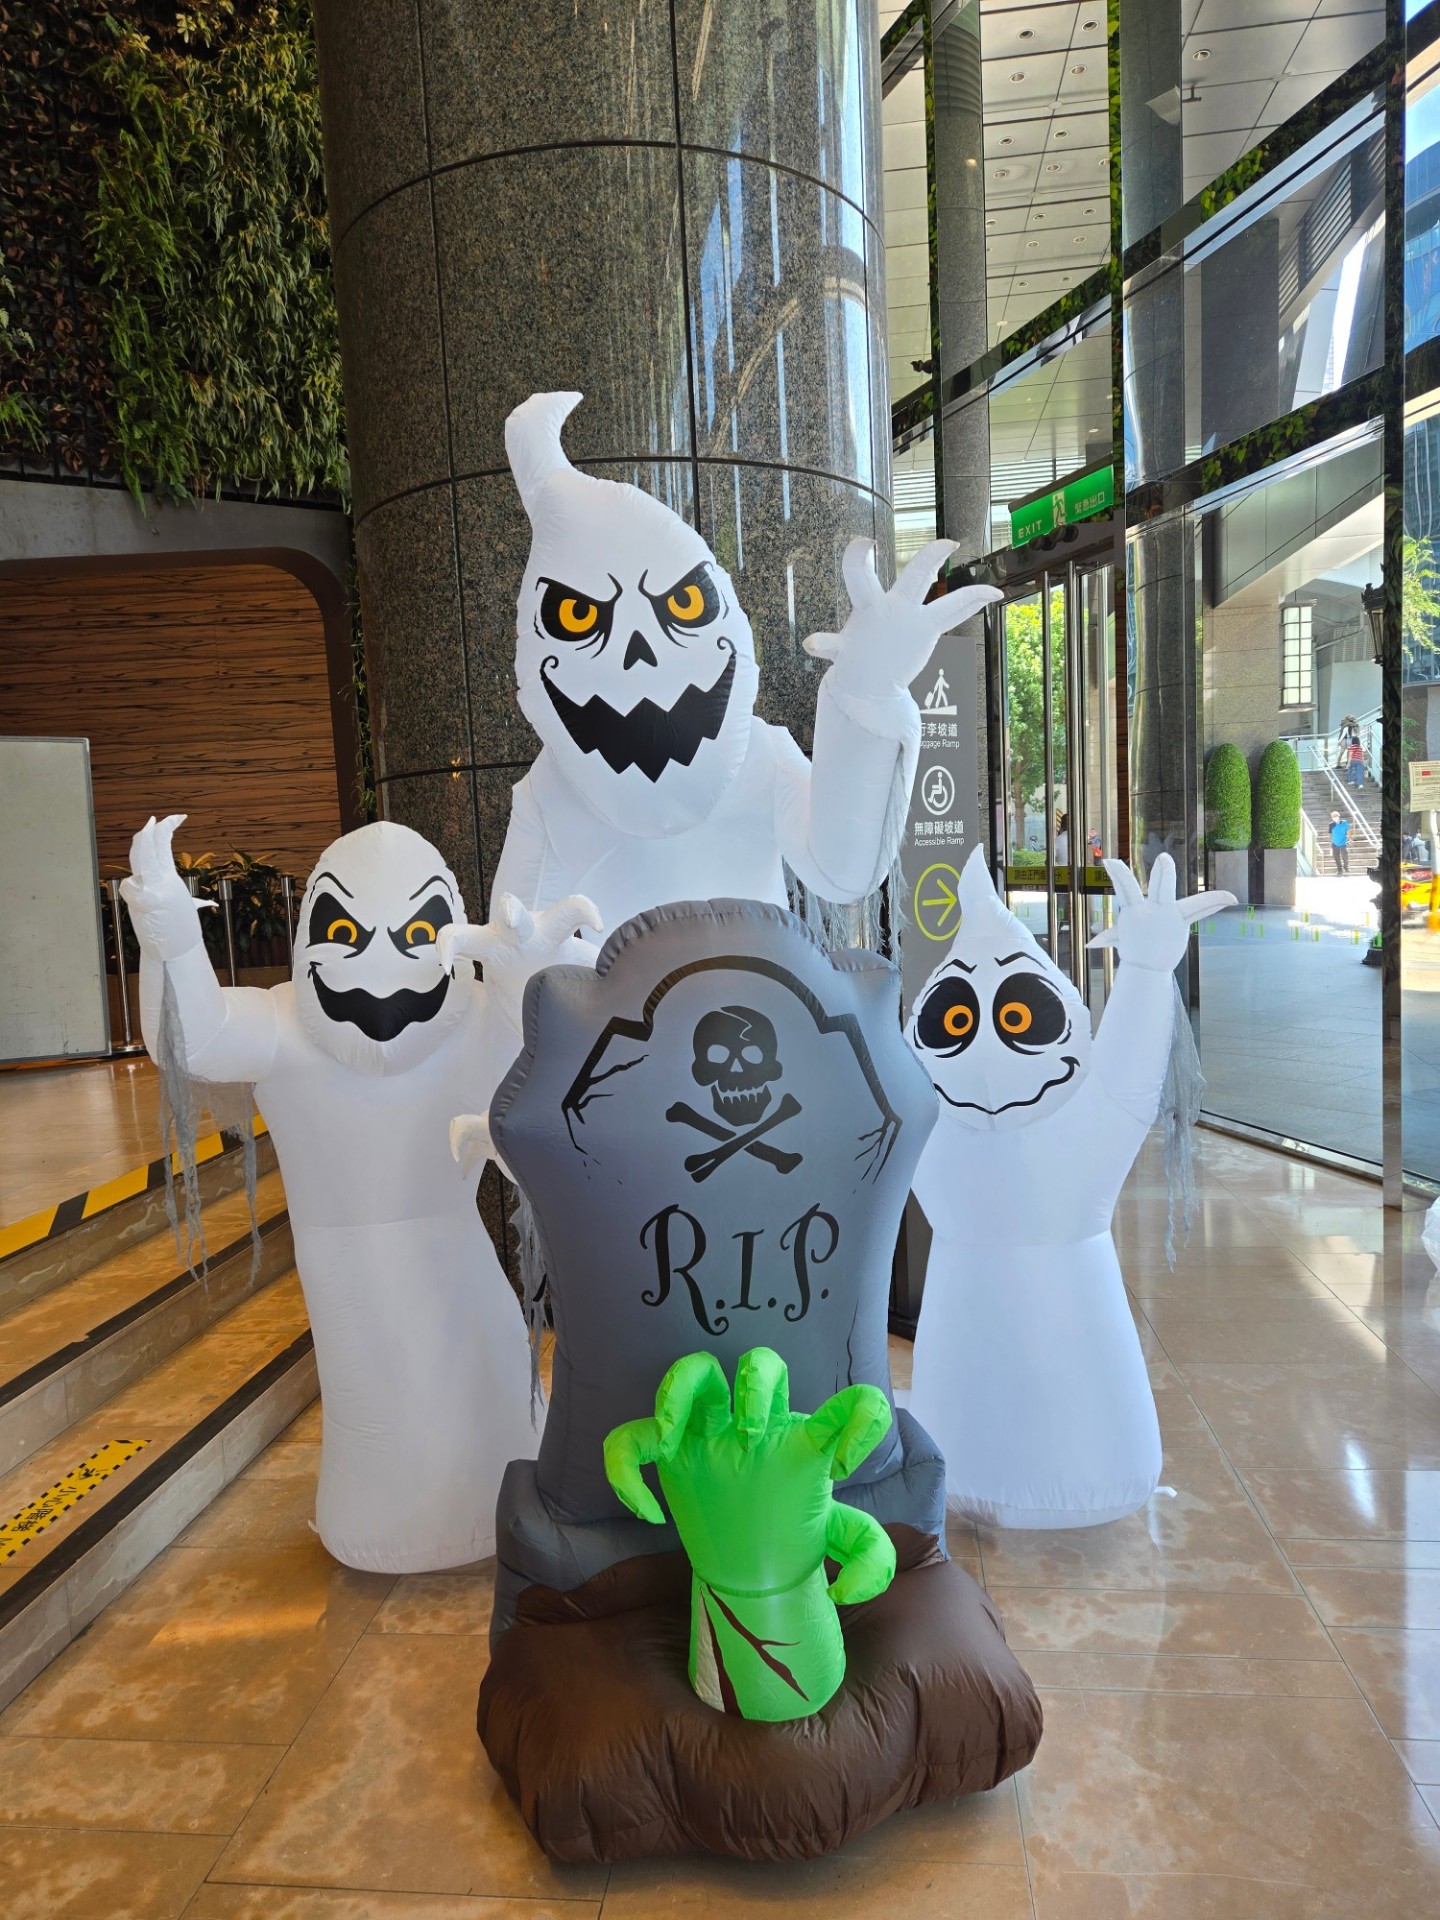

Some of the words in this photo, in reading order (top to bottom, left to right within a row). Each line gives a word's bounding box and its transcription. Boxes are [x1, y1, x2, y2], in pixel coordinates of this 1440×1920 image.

[1018, 520, 1042, 539] EXIT
[920, 740, 941, 749] uggage
[942, 739, 960, 749] Ramp
[914, 820, 964, 836] 無障礙坡道
[914, 837, 946, 846] Accessible
[946, 836, 965, 846] Ramp
[639, 1202, 840, 1336] R.I.P.
